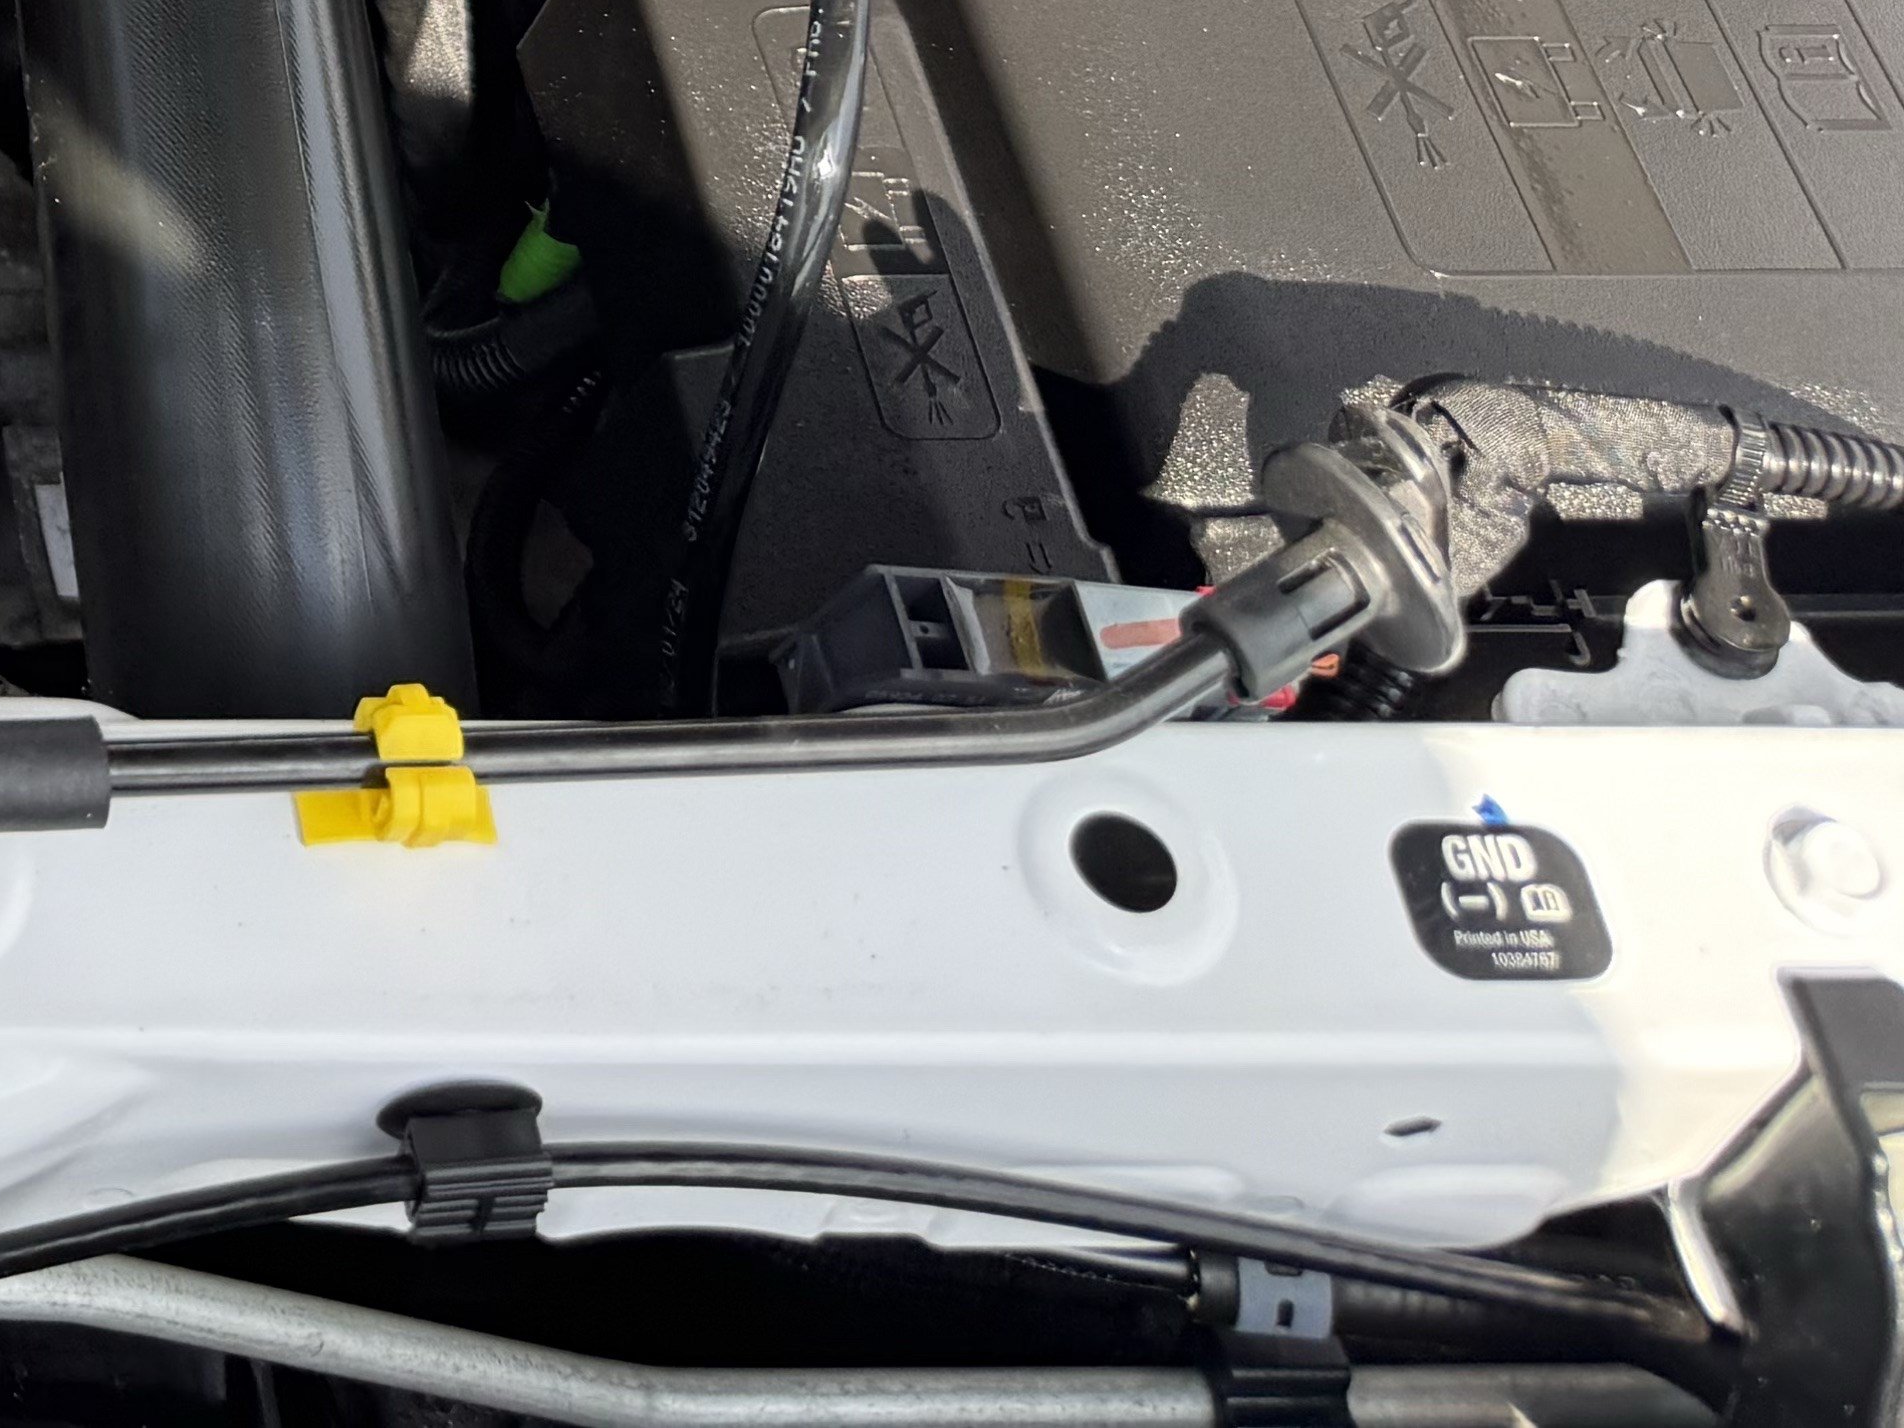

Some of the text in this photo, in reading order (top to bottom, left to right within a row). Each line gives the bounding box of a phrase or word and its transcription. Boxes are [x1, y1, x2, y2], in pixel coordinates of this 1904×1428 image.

[1441, 832, 1539, 883] GND
[1453, 929, 1554, 949] Printed in USA
